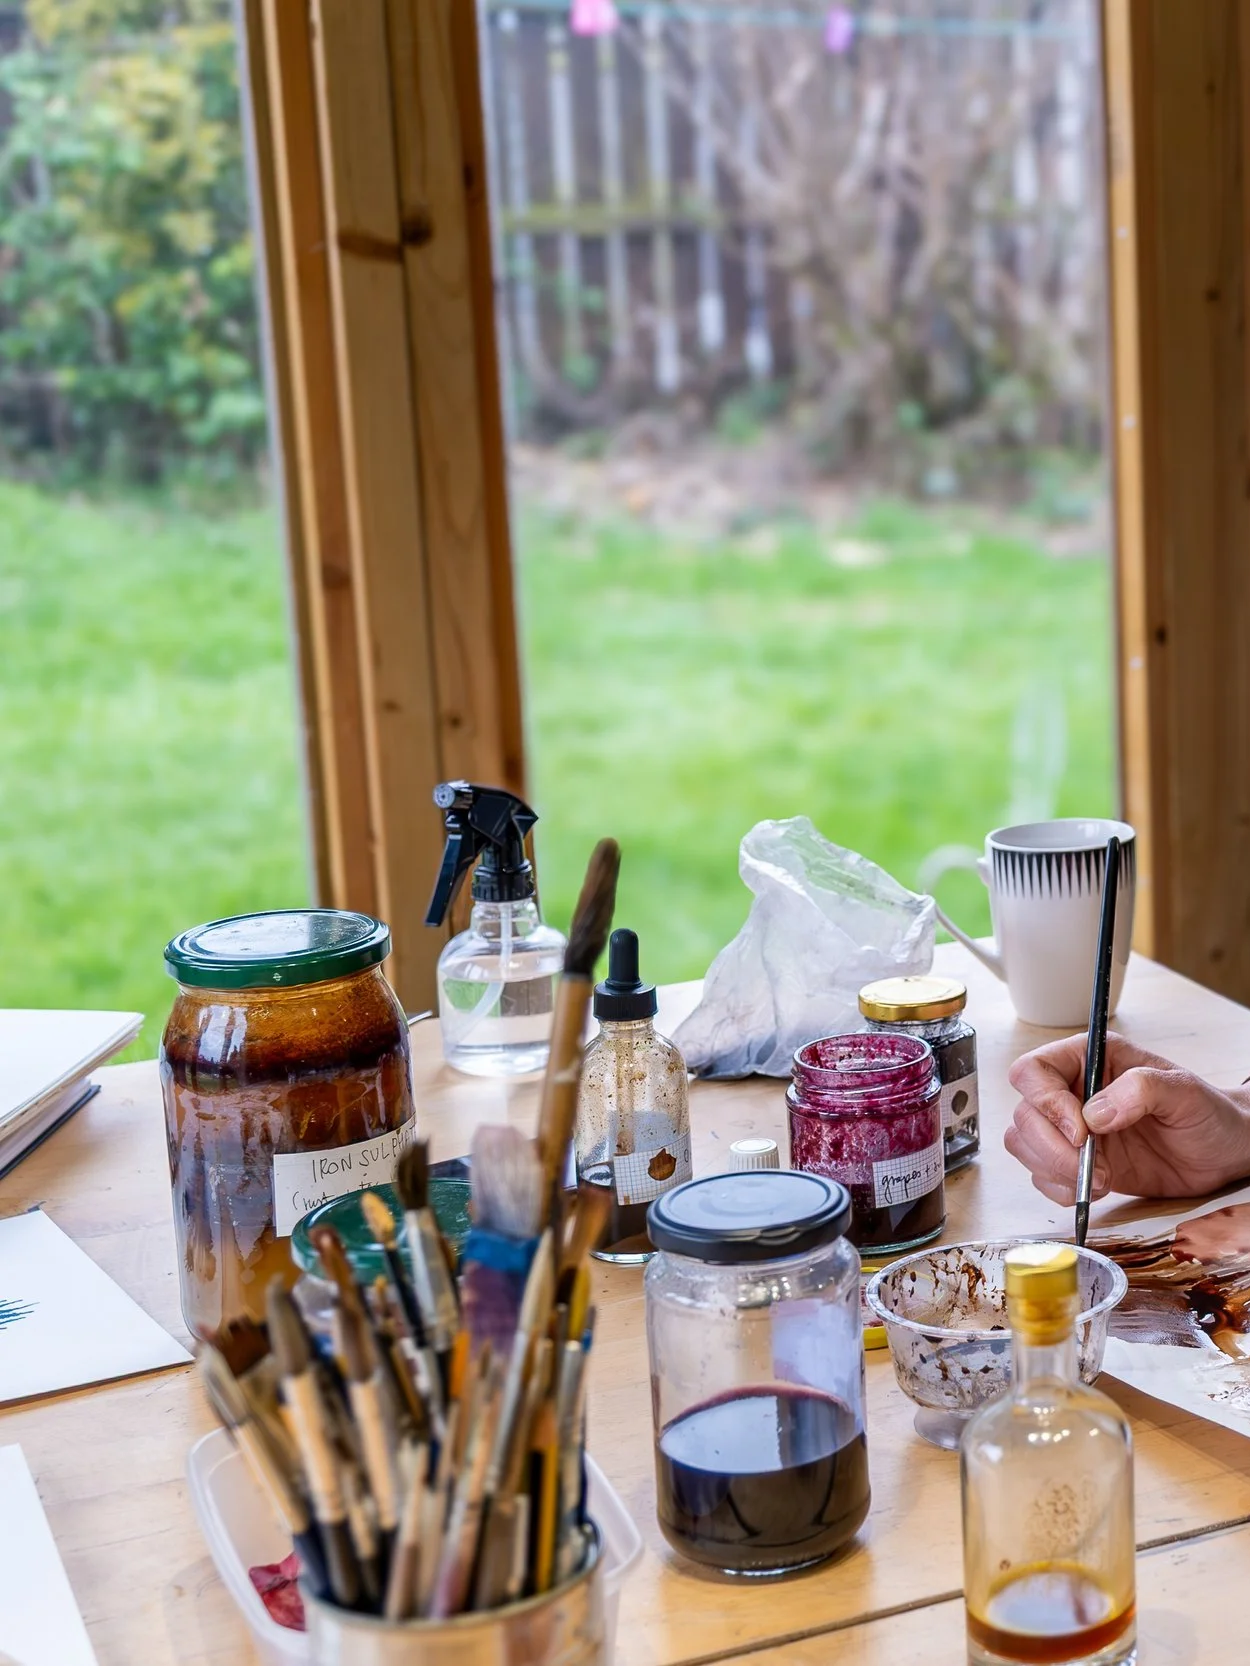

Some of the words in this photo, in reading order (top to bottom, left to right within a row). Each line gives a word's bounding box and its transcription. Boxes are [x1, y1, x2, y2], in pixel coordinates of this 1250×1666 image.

[312, 1153, 352, 1183] IRON
[359, 1124, 417, 1167] SULPHAT
[881, 1170, 921, 1204] grapes
